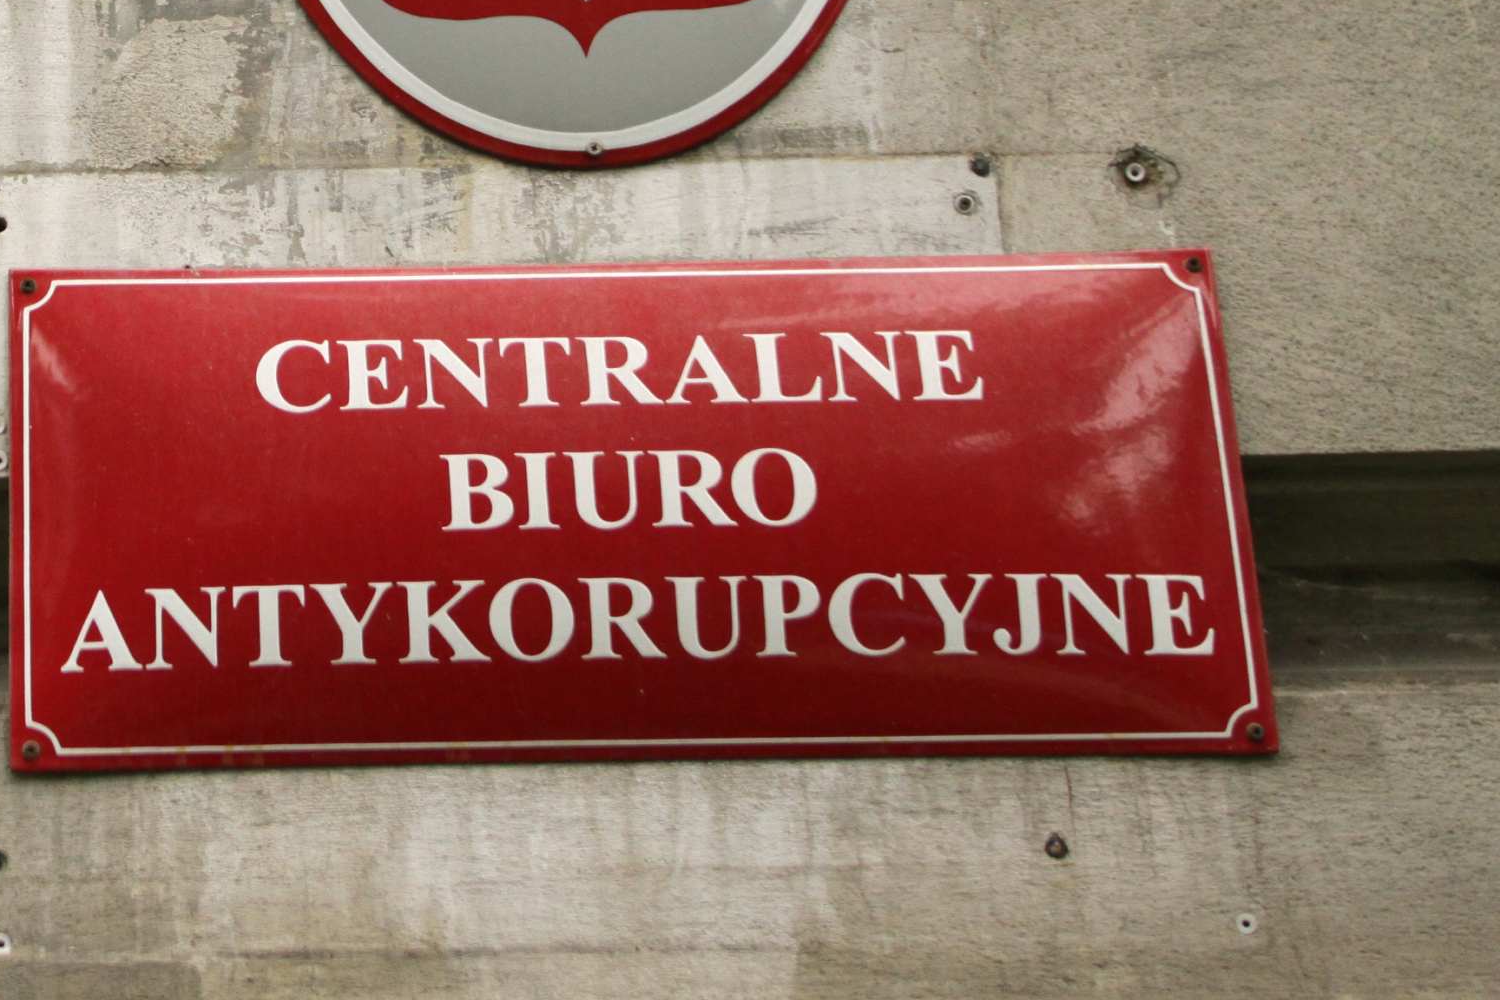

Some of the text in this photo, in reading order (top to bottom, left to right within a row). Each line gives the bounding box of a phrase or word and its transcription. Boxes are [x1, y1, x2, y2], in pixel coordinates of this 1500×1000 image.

[255, 329, 984, 414] CENTRALNE
[439, 447, 817, 531] BIURO
[60, 572, 1216, 673] ANTYKORUPCYJNE
